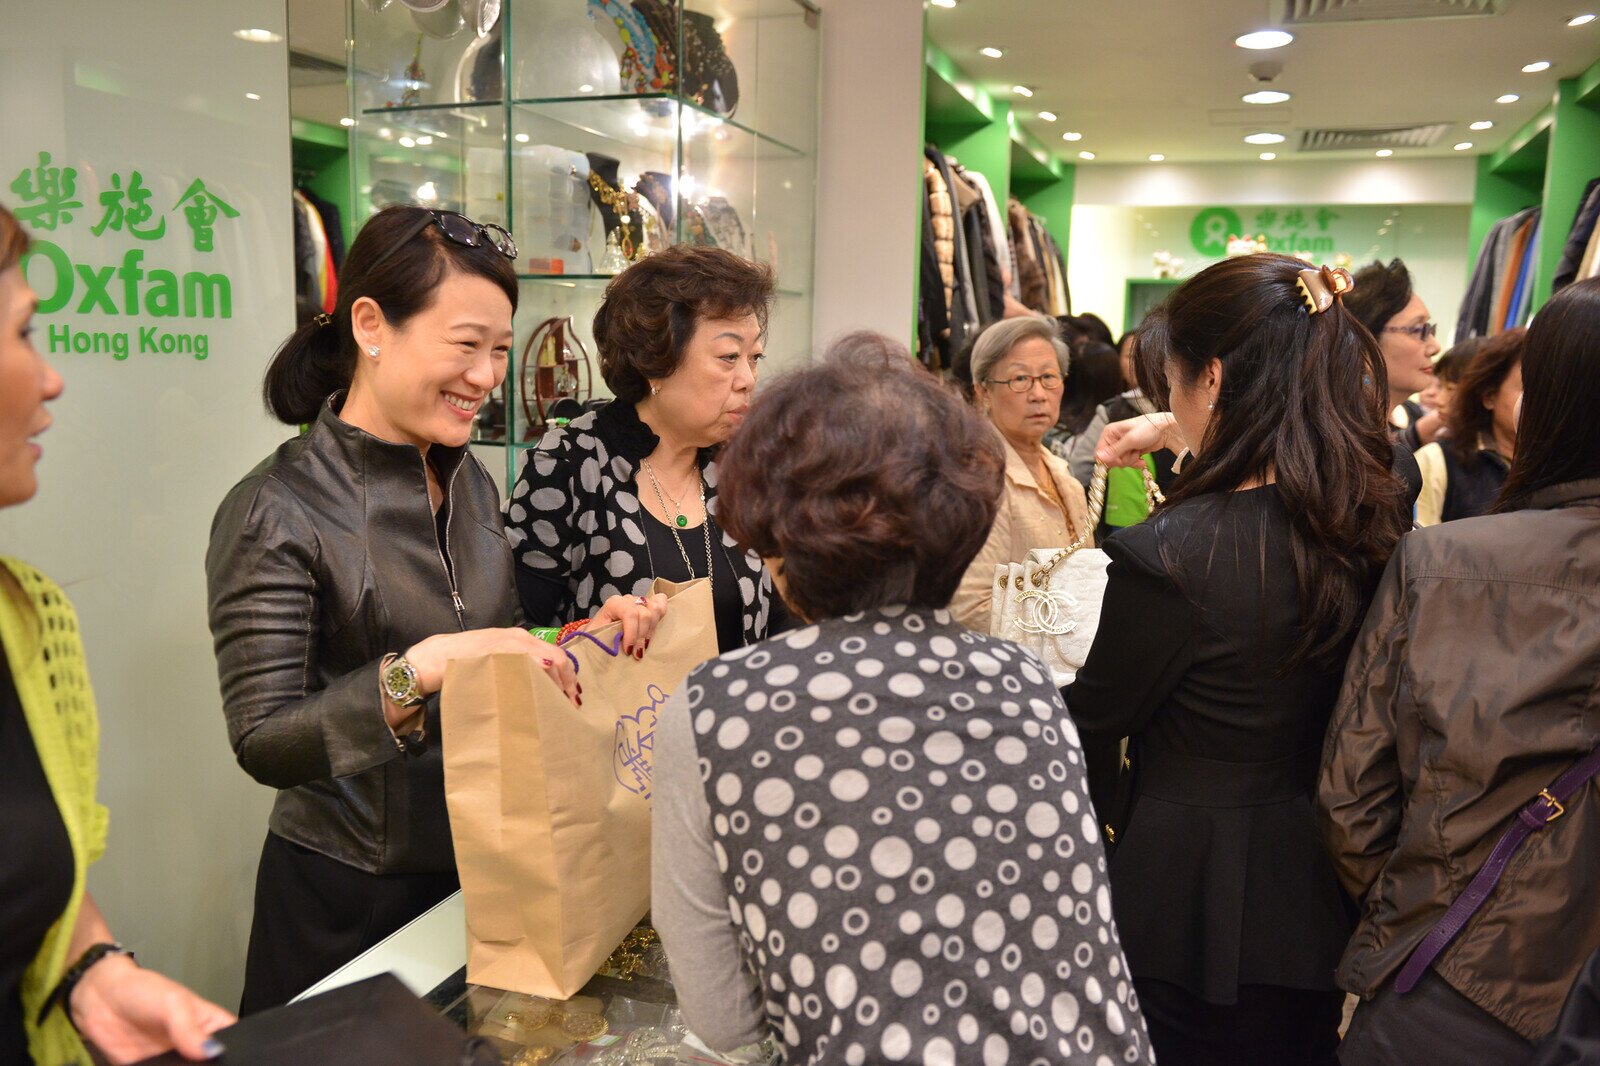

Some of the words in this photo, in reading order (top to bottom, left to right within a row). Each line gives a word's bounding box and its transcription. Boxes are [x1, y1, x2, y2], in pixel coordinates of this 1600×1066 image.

[10, 151, 240, 252] 樂施會
[19, 239, 233, 319] Oxfam
[49, 324, 129, 361] Hong
[139, 326, 209, 361] Kong
